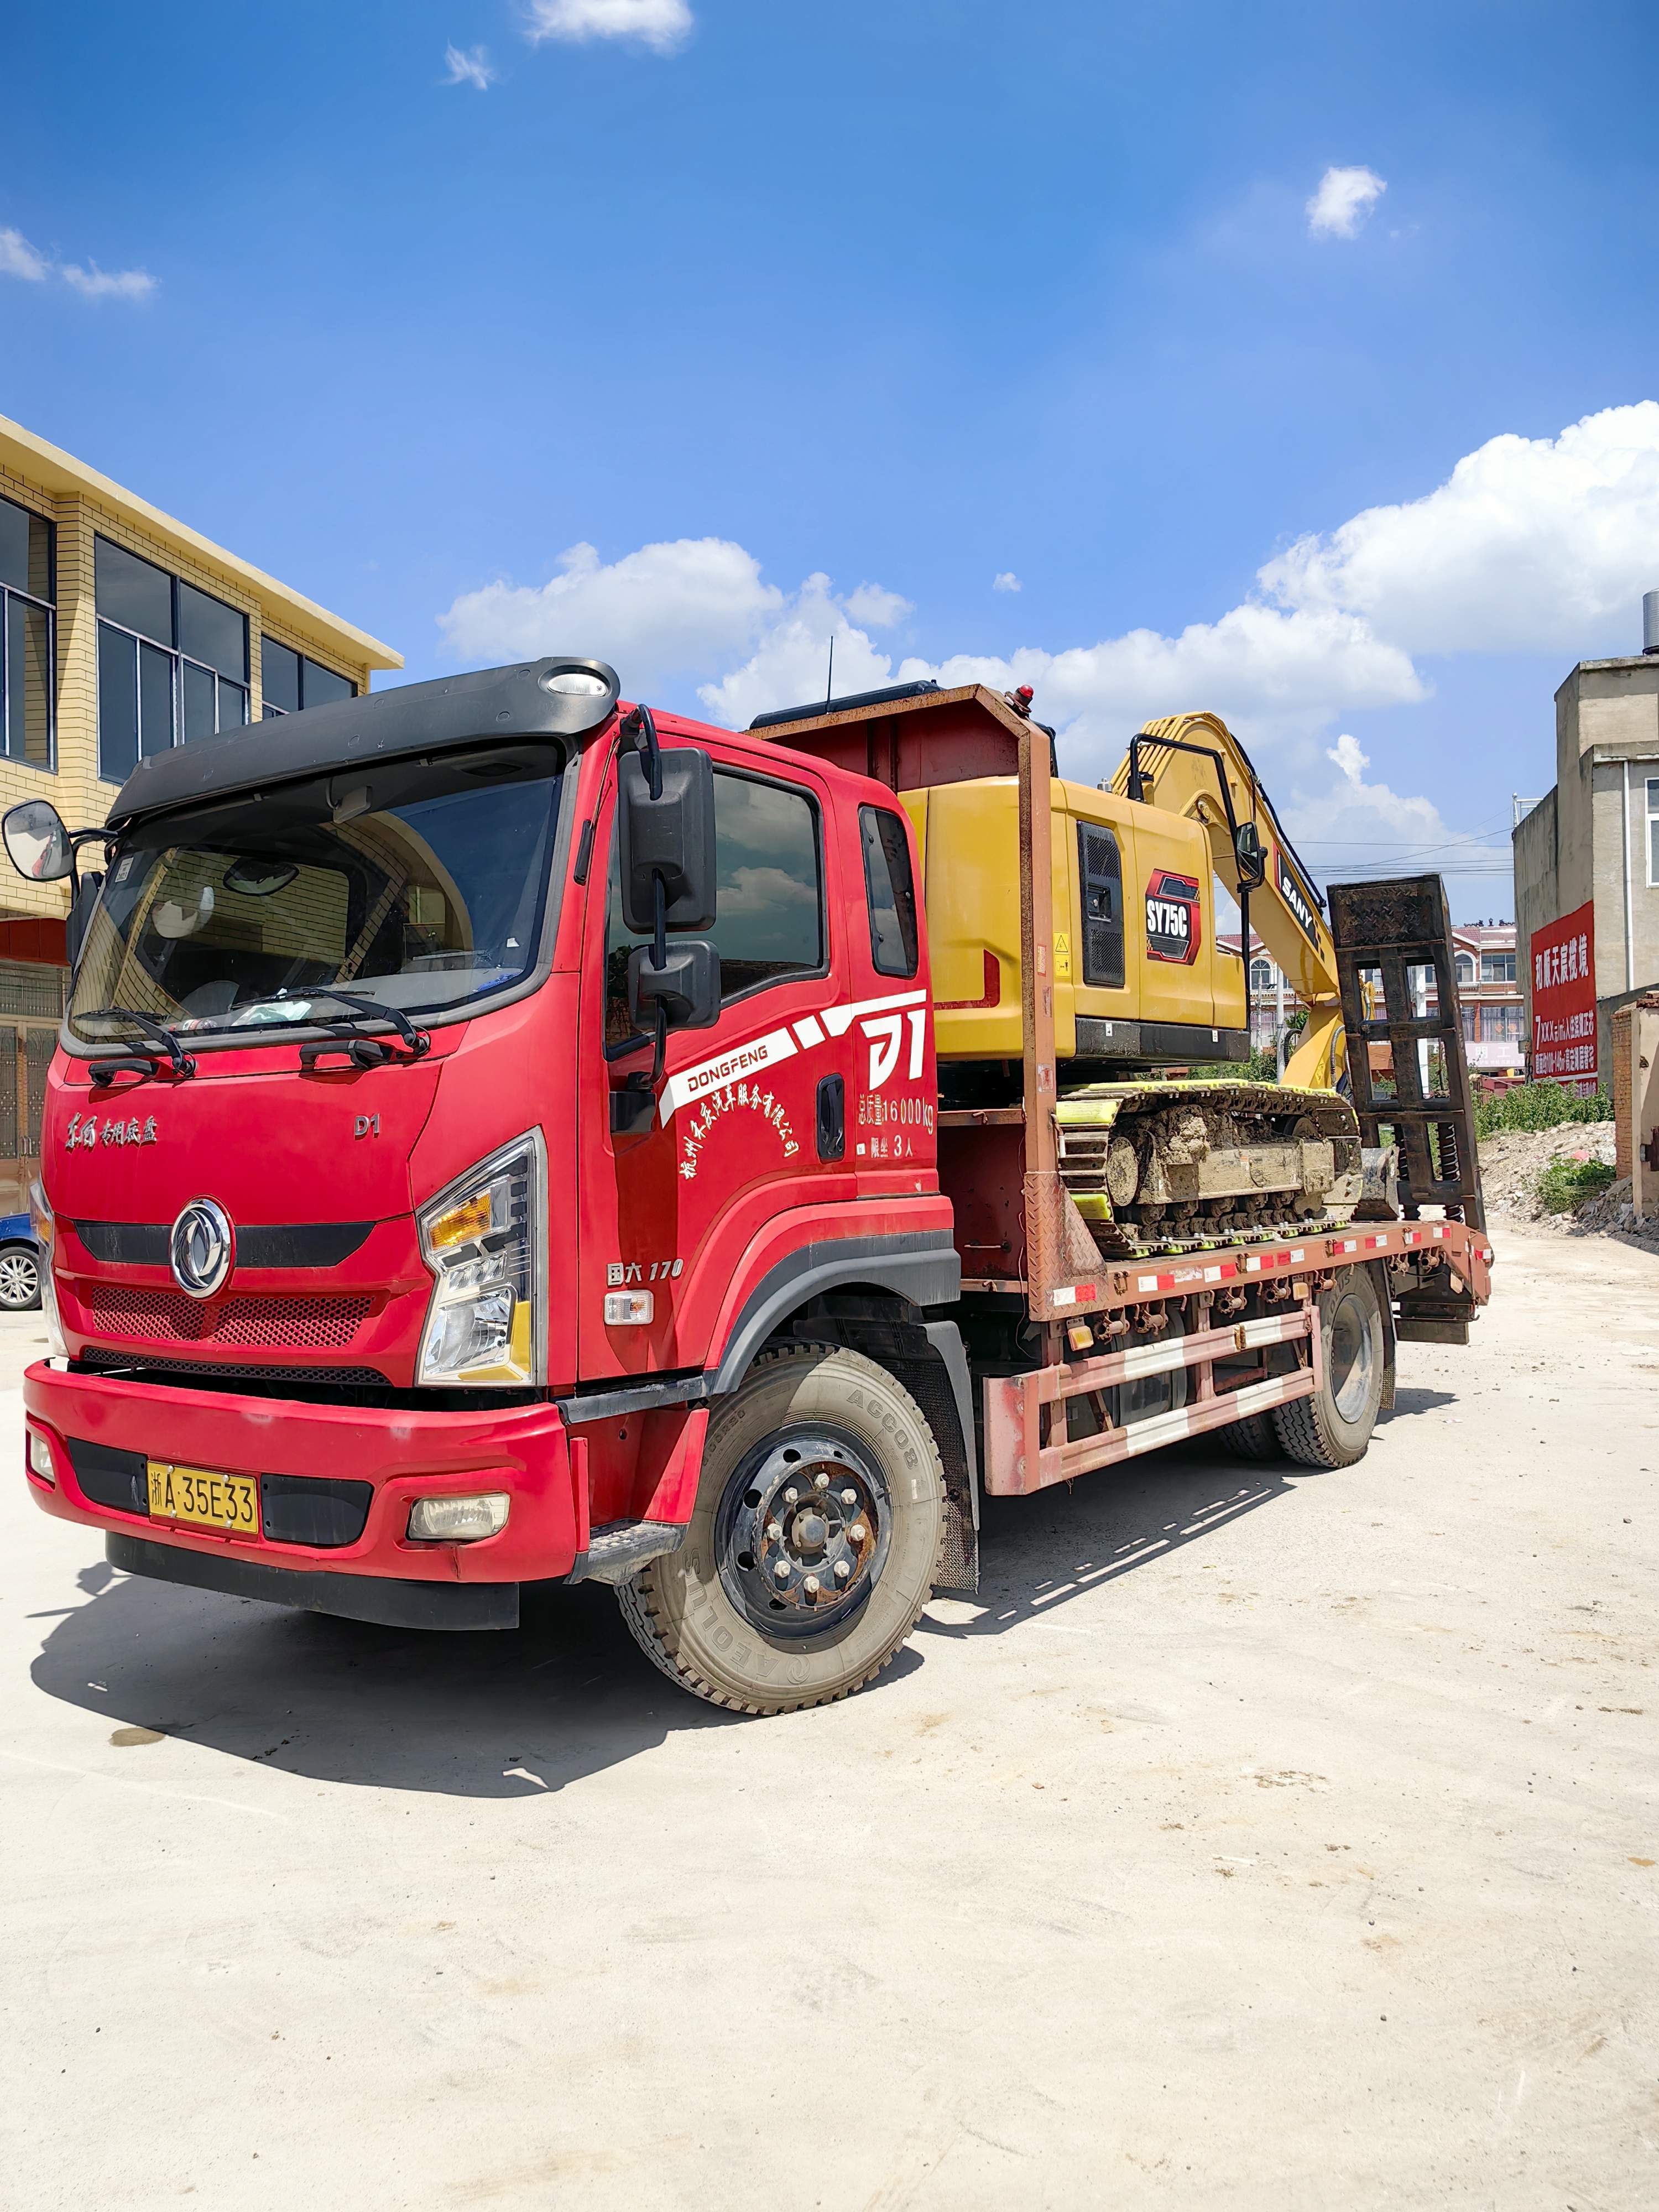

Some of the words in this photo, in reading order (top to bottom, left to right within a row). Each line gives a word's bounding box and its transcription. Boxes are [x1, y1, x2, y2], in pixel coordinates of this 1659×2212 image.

[1146, 899, 1188, 937] SY75C
[1282, 876, 1313, 929] SANY
[687, 1045, 769, 1093] DONGFENG
[101, 1114, 158, 1146] 专用底盘
[354, 1113, 380, 1136] D1
[607, 1262, 642, 1286] 国六
[649, 1258, 684, 1281] 170
[682, 1548, 779, 1677] AEOLUS
